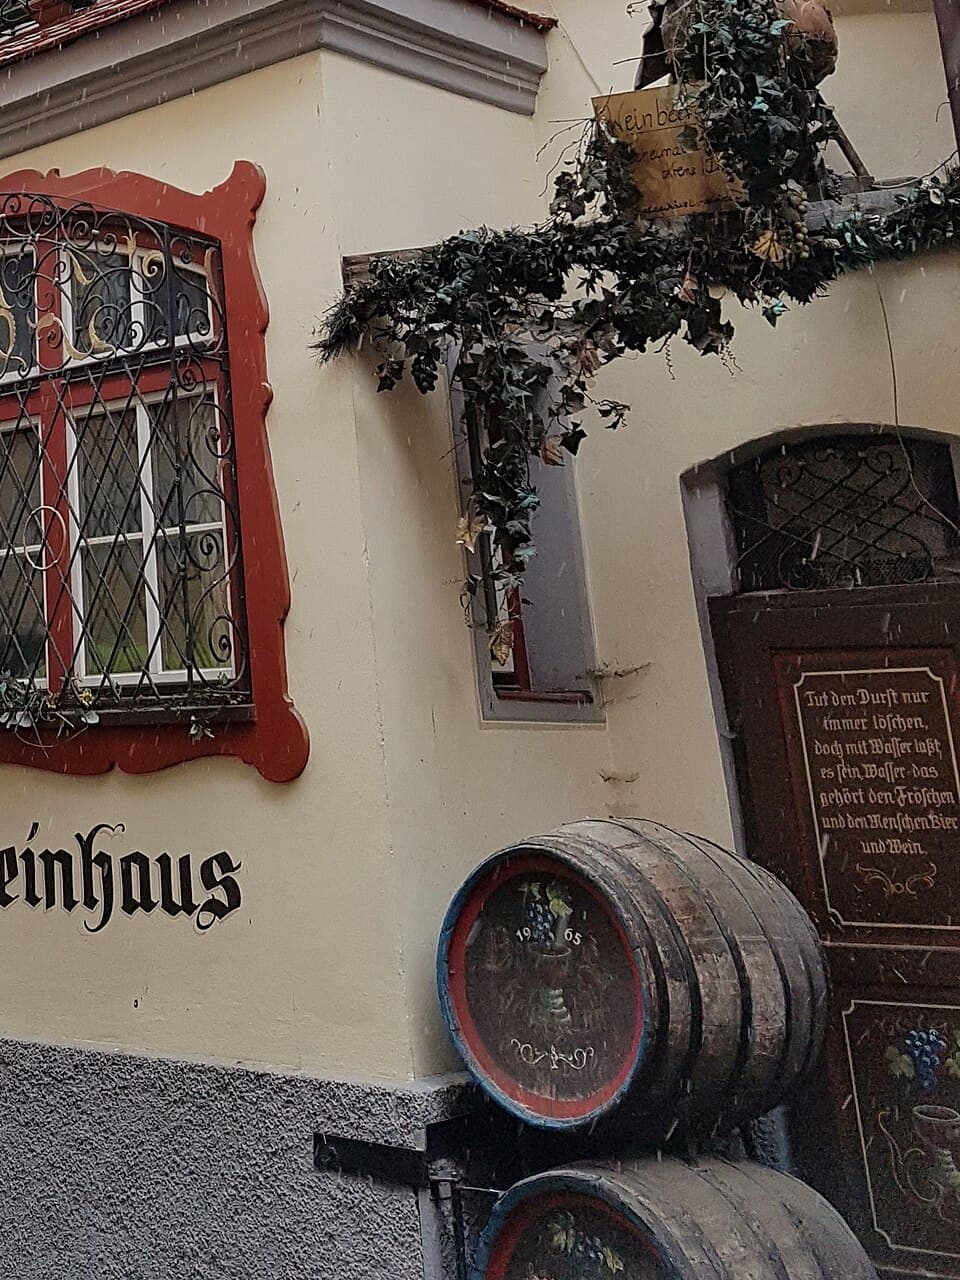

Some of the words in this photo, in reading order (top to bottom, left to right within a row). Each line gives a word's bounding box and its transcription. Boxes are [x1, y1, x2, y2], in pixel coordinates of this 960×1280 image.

[831, 690, 856, 706] den
[902, 691, 930, 704] nur
[814, 739, 844, 758] doch
[845, 740, 868, 755] mit
[820, 767, 834, 779] es
[912, 763, 939, 779] das
[820, 788, 865, 808] gehört
[868, 788, 894, 805] den
[822, 814, 846, 829] und
[847, 813, 868, 828] den
[861, 839, 886, 854] und
[516, 927, 531, 942] 19
[564, 928, 583, 945] 65
